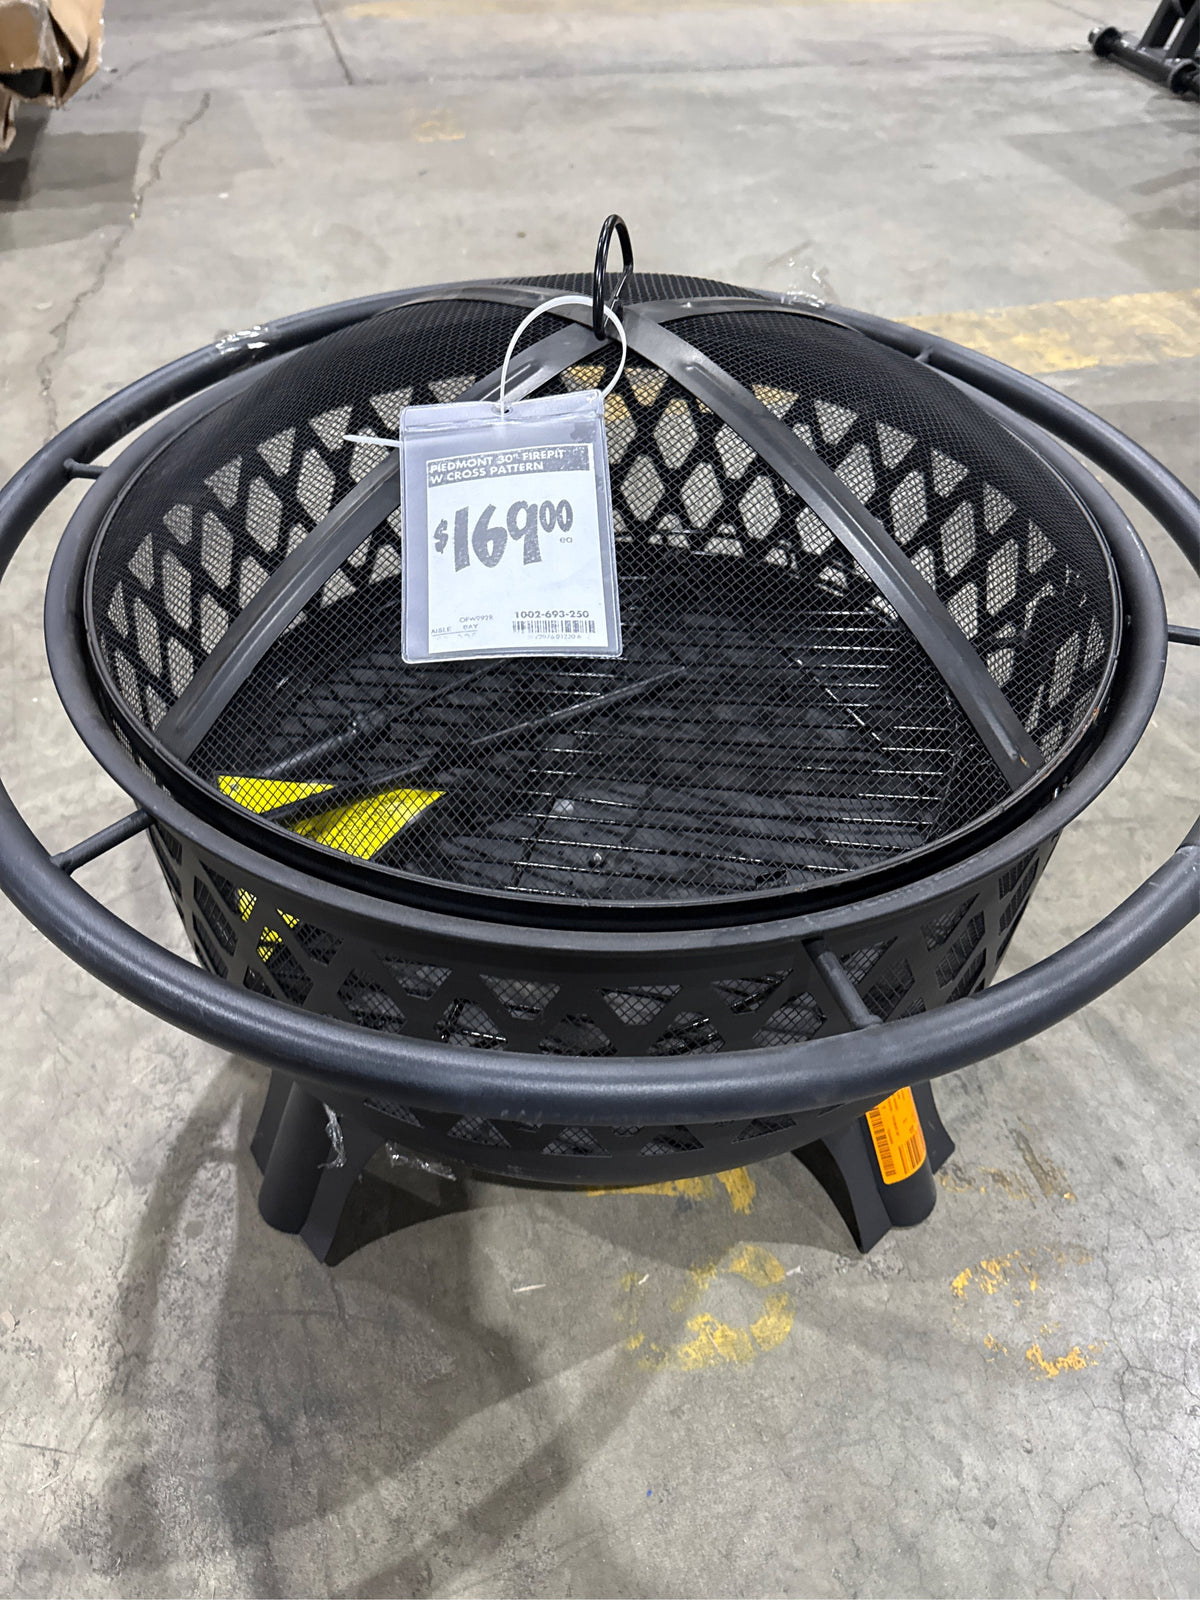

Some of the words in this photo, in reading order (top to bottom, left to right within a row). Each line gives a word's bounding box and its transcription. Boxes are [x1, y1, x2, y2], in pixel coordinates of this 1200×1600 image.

[430, 456, 493, 474] PIEDMONT
[522, 449, 565, 462] FIREPIT
[430, 475, 443, 485] W
[446, 469, 486, 482] CROSS
[490, 461, 544, 476] PATTERN
[515, 610, 590, 619] 1002-693-250
